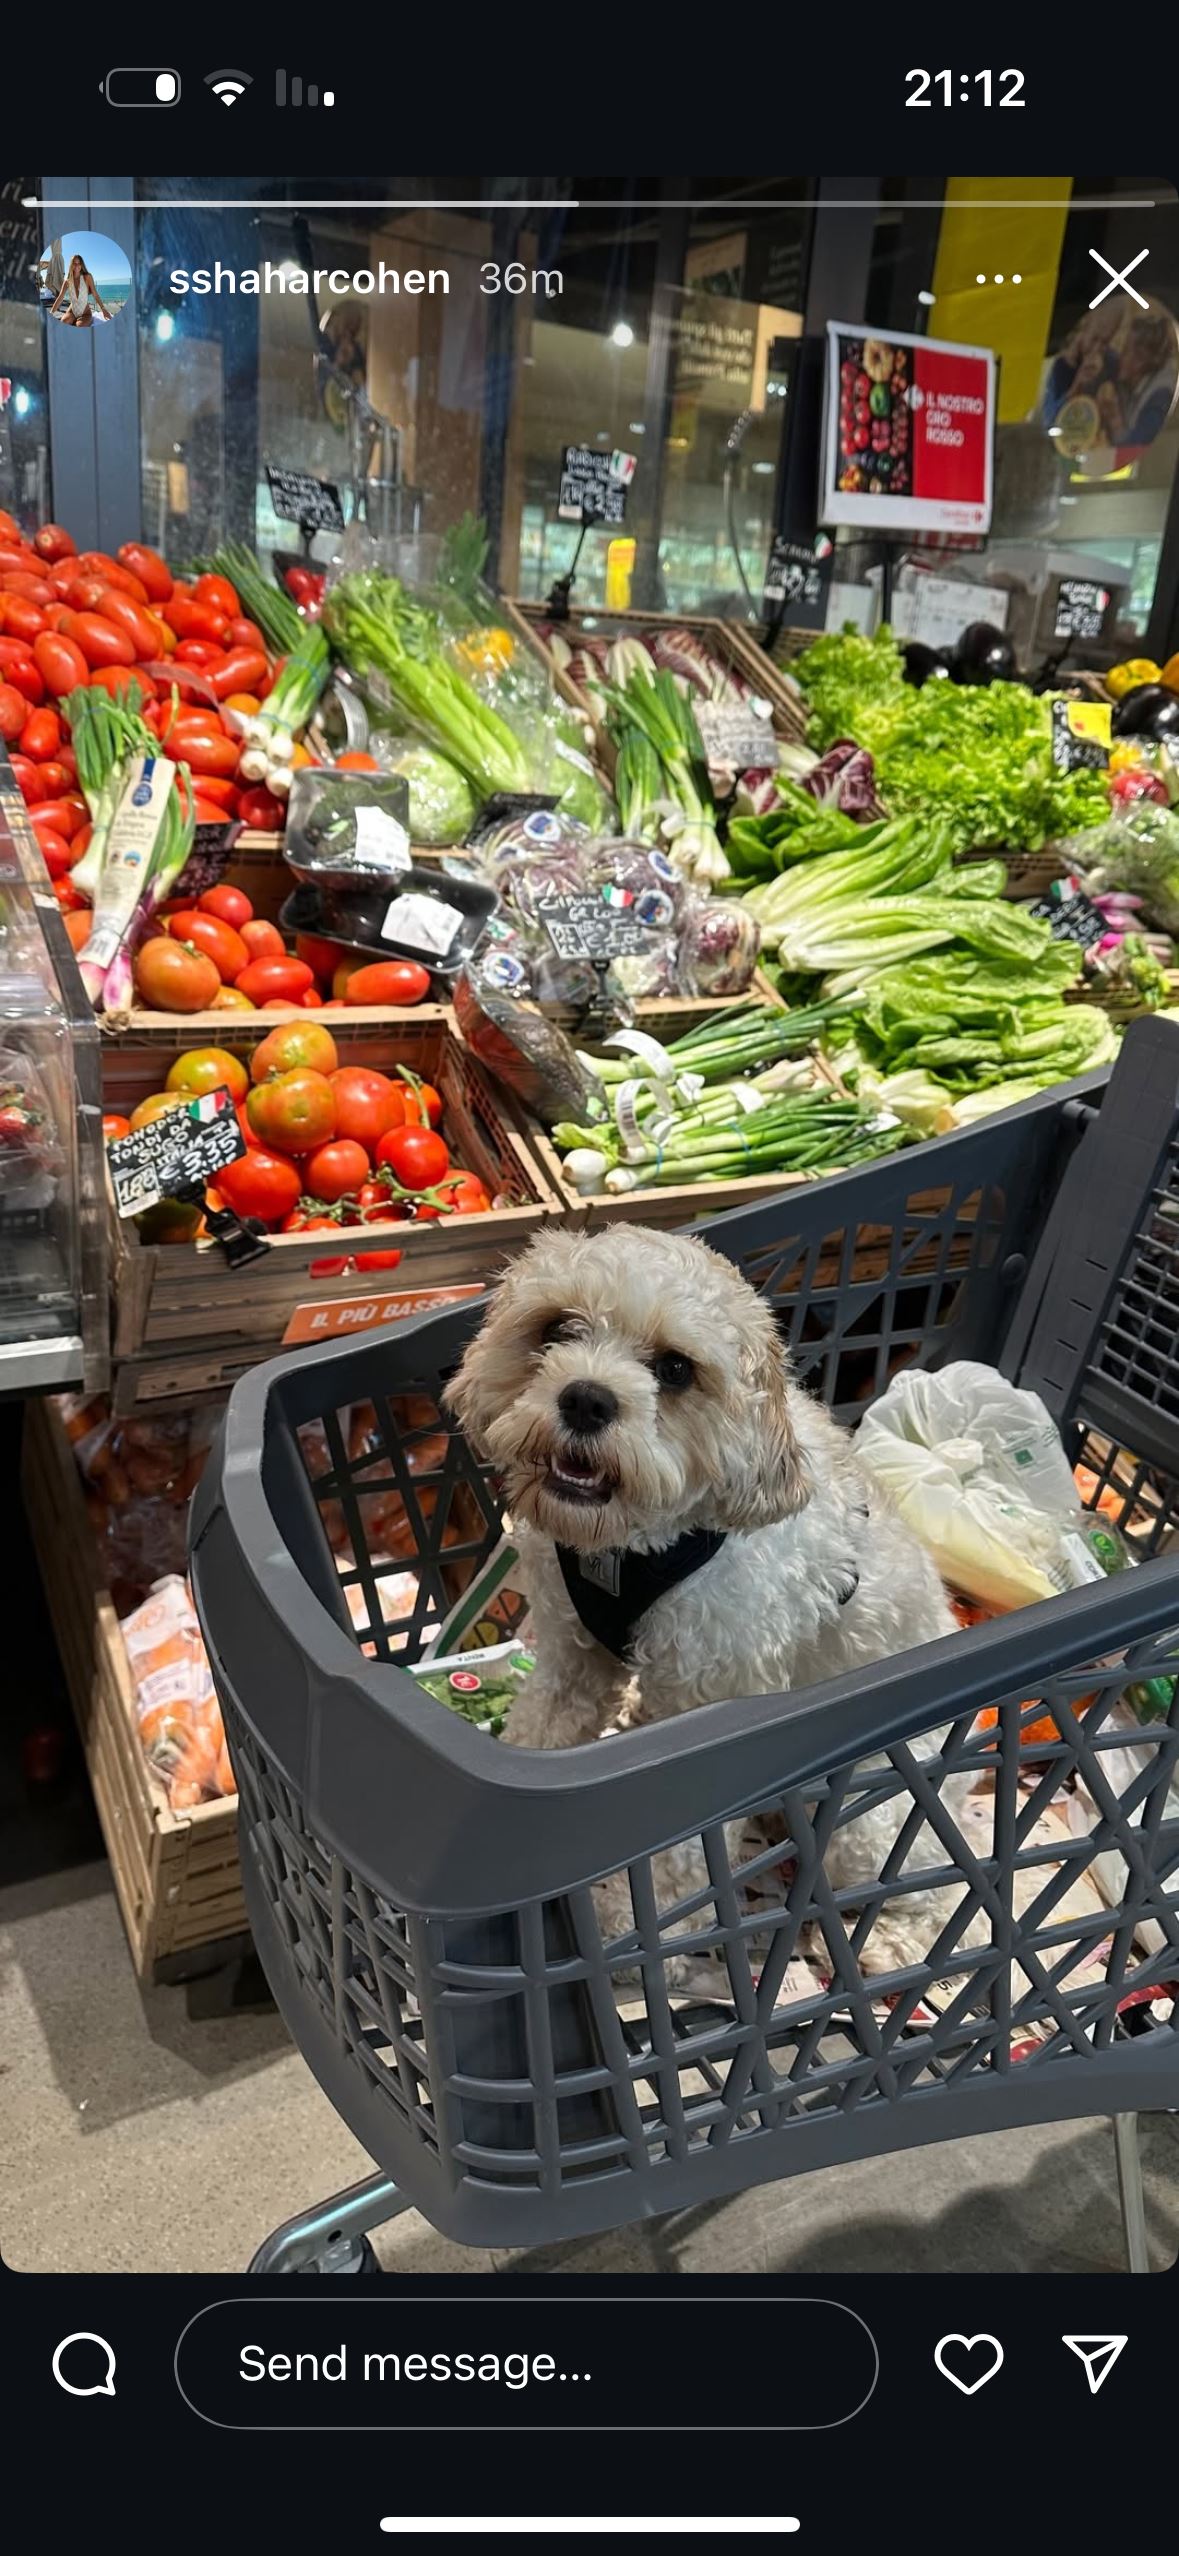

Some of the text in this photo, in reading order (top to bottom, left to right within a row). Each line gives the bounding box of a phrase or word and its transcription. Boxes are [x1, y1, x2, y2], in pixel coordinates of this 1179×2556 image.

[937, 393, 985, 416] NOSTRO
[926, 426, 965, 448] ROSSO
[110, 1117, 192, 1164] TONDI DA
[112, 1106, 190, 1152] POMODOR
[310, 1311, 329, 1329] IL
[337, 1302, 379, 1326] PIÙ
